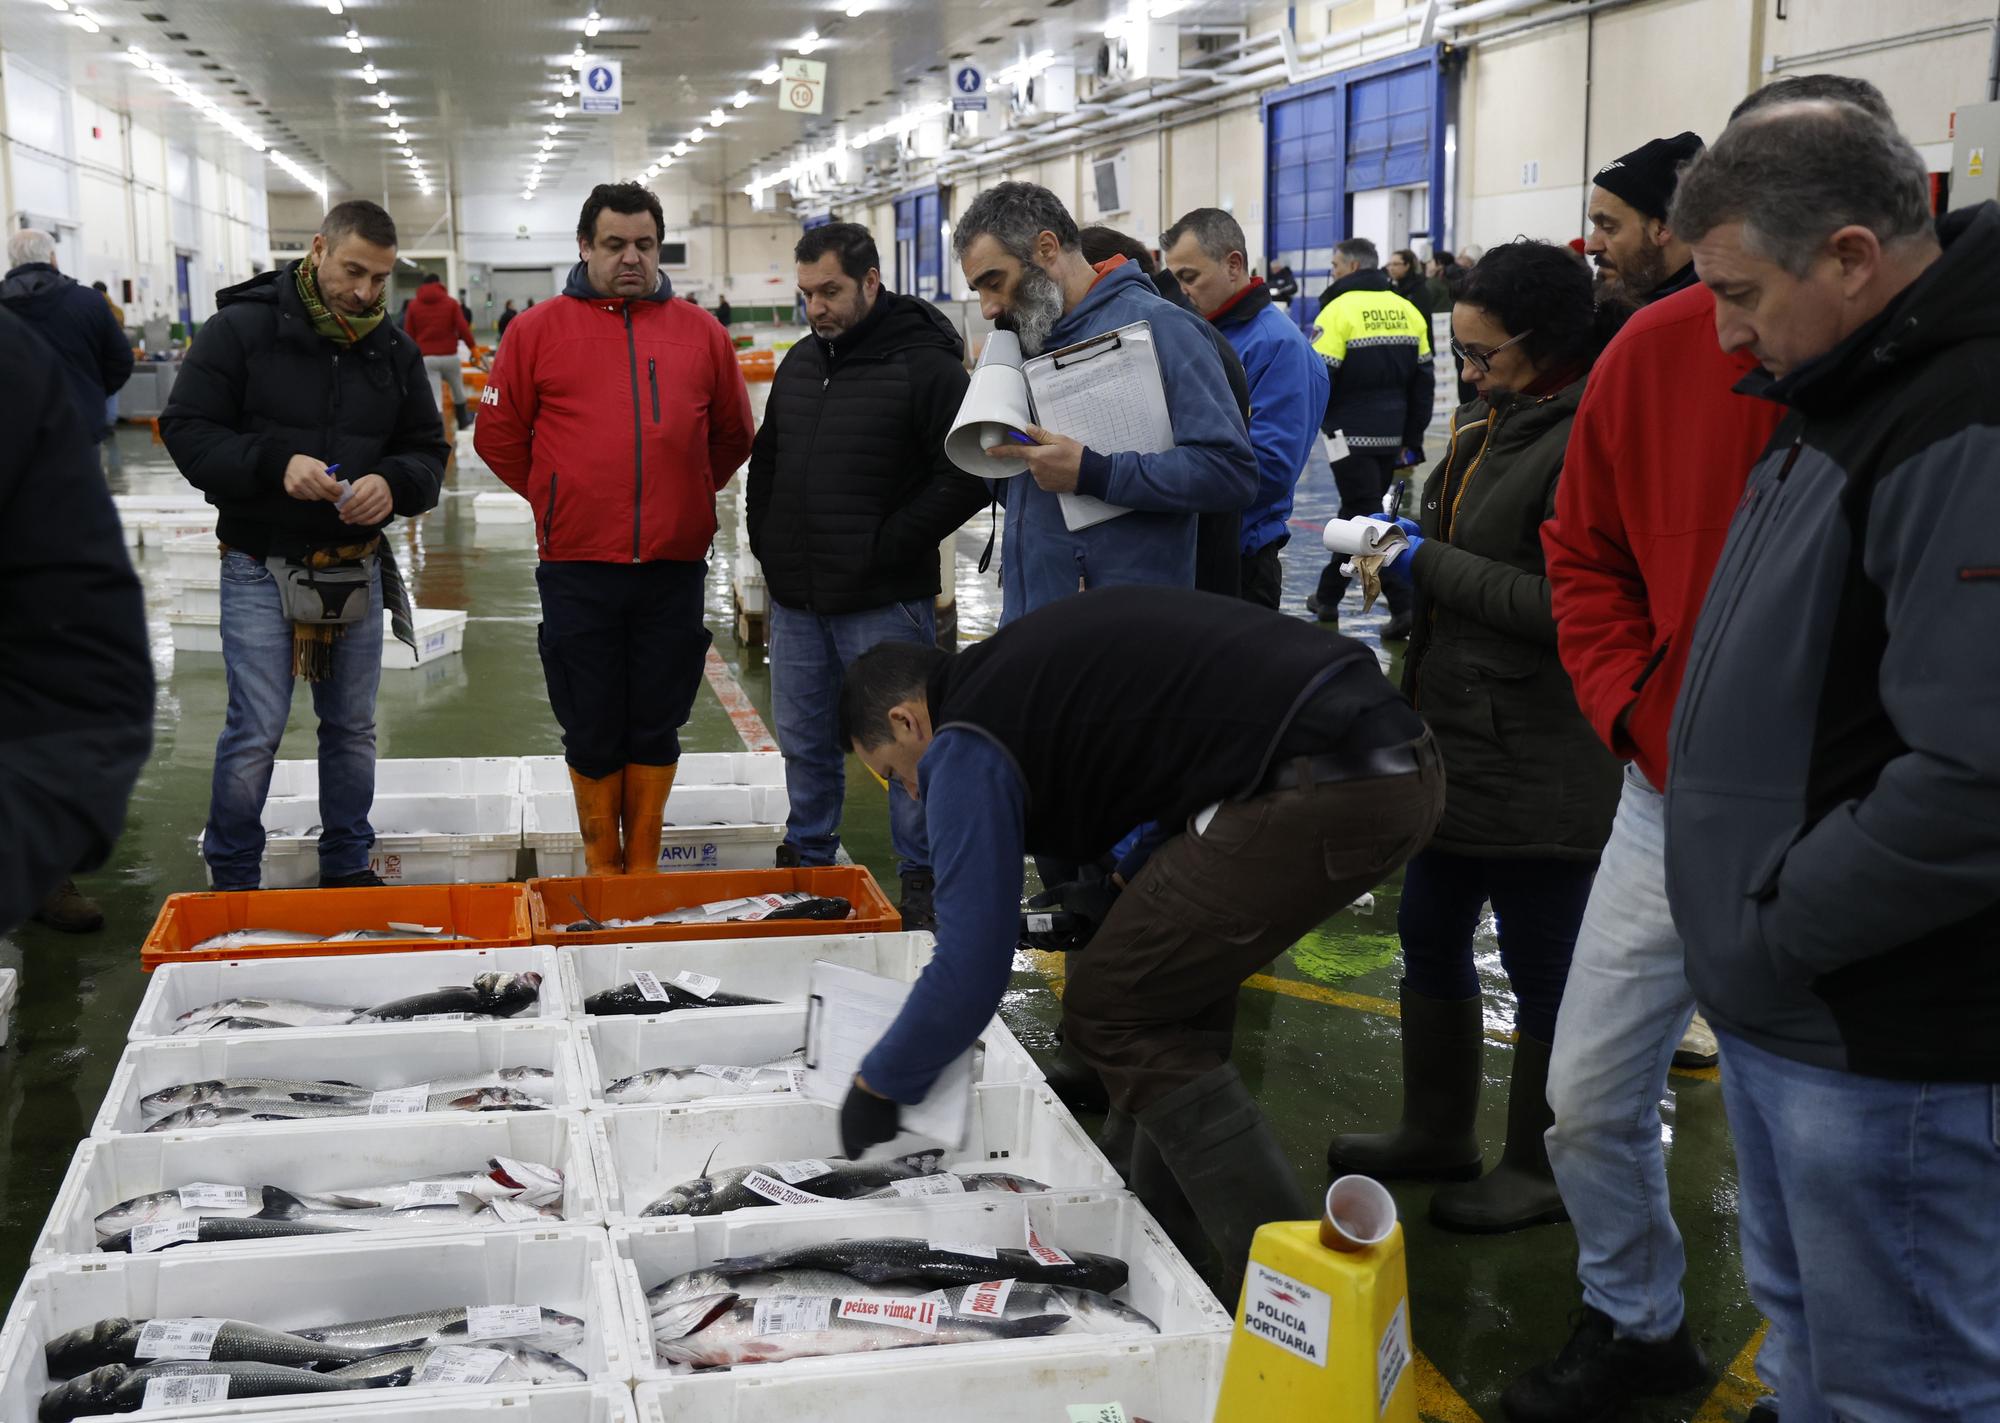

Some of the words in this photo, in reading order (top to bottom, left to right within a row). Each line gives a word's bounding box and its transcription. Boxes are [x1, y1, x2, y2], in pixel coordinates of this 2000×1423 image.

[1362, 309, 1407, 322] POLICIA
[1364, 320, 1409, 331] PORTUARIA
[661, 845, 697, 860] ARVI
[750, 1175, 784, 1199] HERVELLA
[1259, 1268, 1283, 1287] Puerto
[1284, 1281, 1293, 1291] de
[1294, 1285, 1311, 1300] Vigo
[843, 1298, 879, 1317] peixes
[883, 1300, 917, 1320] vimar
[1257, 1300, 1306, 1335] POLICIA
[1245, 1313, 1317, 1359] PORTUARIA
